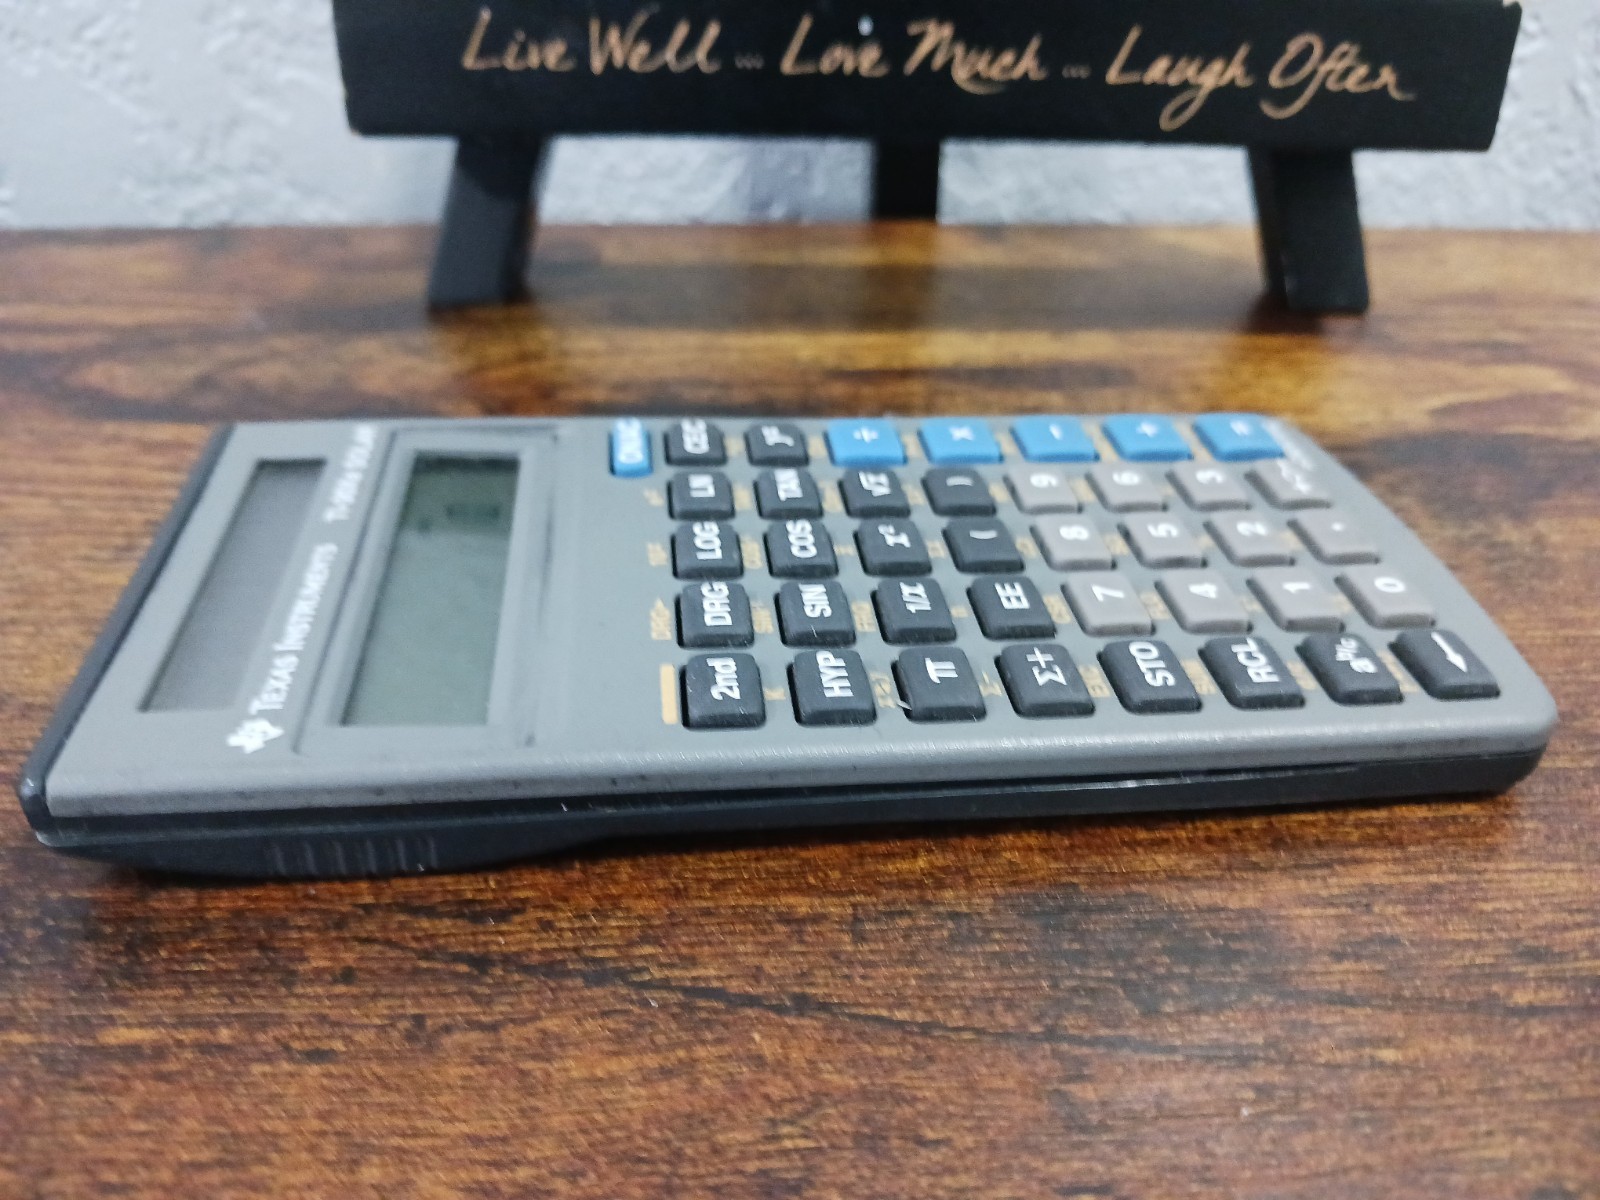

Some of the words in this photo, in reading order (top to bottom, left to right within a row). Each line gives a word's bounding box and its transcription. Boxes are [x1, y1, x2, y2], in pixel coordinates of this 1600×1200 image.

[462, 6, 577, 72] Live
[588, 2, 722, 76] Well
[780, 13, 891, 78] Love
[904, 17, 1049, 94] Much
[1105, 24, 1254, 132] Laugh
[1261, 32, 1416, 120] Often
[1030, 472, 1058, 488] 9
[1112, 470, 1140, 486] 6
[1195, 468, 1224, 484] 3
[692, 520, 723, 560] LOG
[785, 518, 817, 558] COS
[1059, 525, 1090, 541] 8
[1147, 522, 1178, 538] 5
[1236, 521, 1268, 536] 2
[994, 581, 1031, 610] EE
[1091, 583, 1125, 602] 7
[1188, 582, 1218, 599] 4
[1282, 581, 1311, 594] 1
[1373, 576, 1407, 594] 0
[700, 581, 732, 626] DRG
[798, 583, 833, 618] SIN
[1128, 641, 1176, 687] STO
[1230, 637, 1281, 683] RCL
[706, 657, 742, 701] 2nd
[816, 650, 854, 698] HYP
